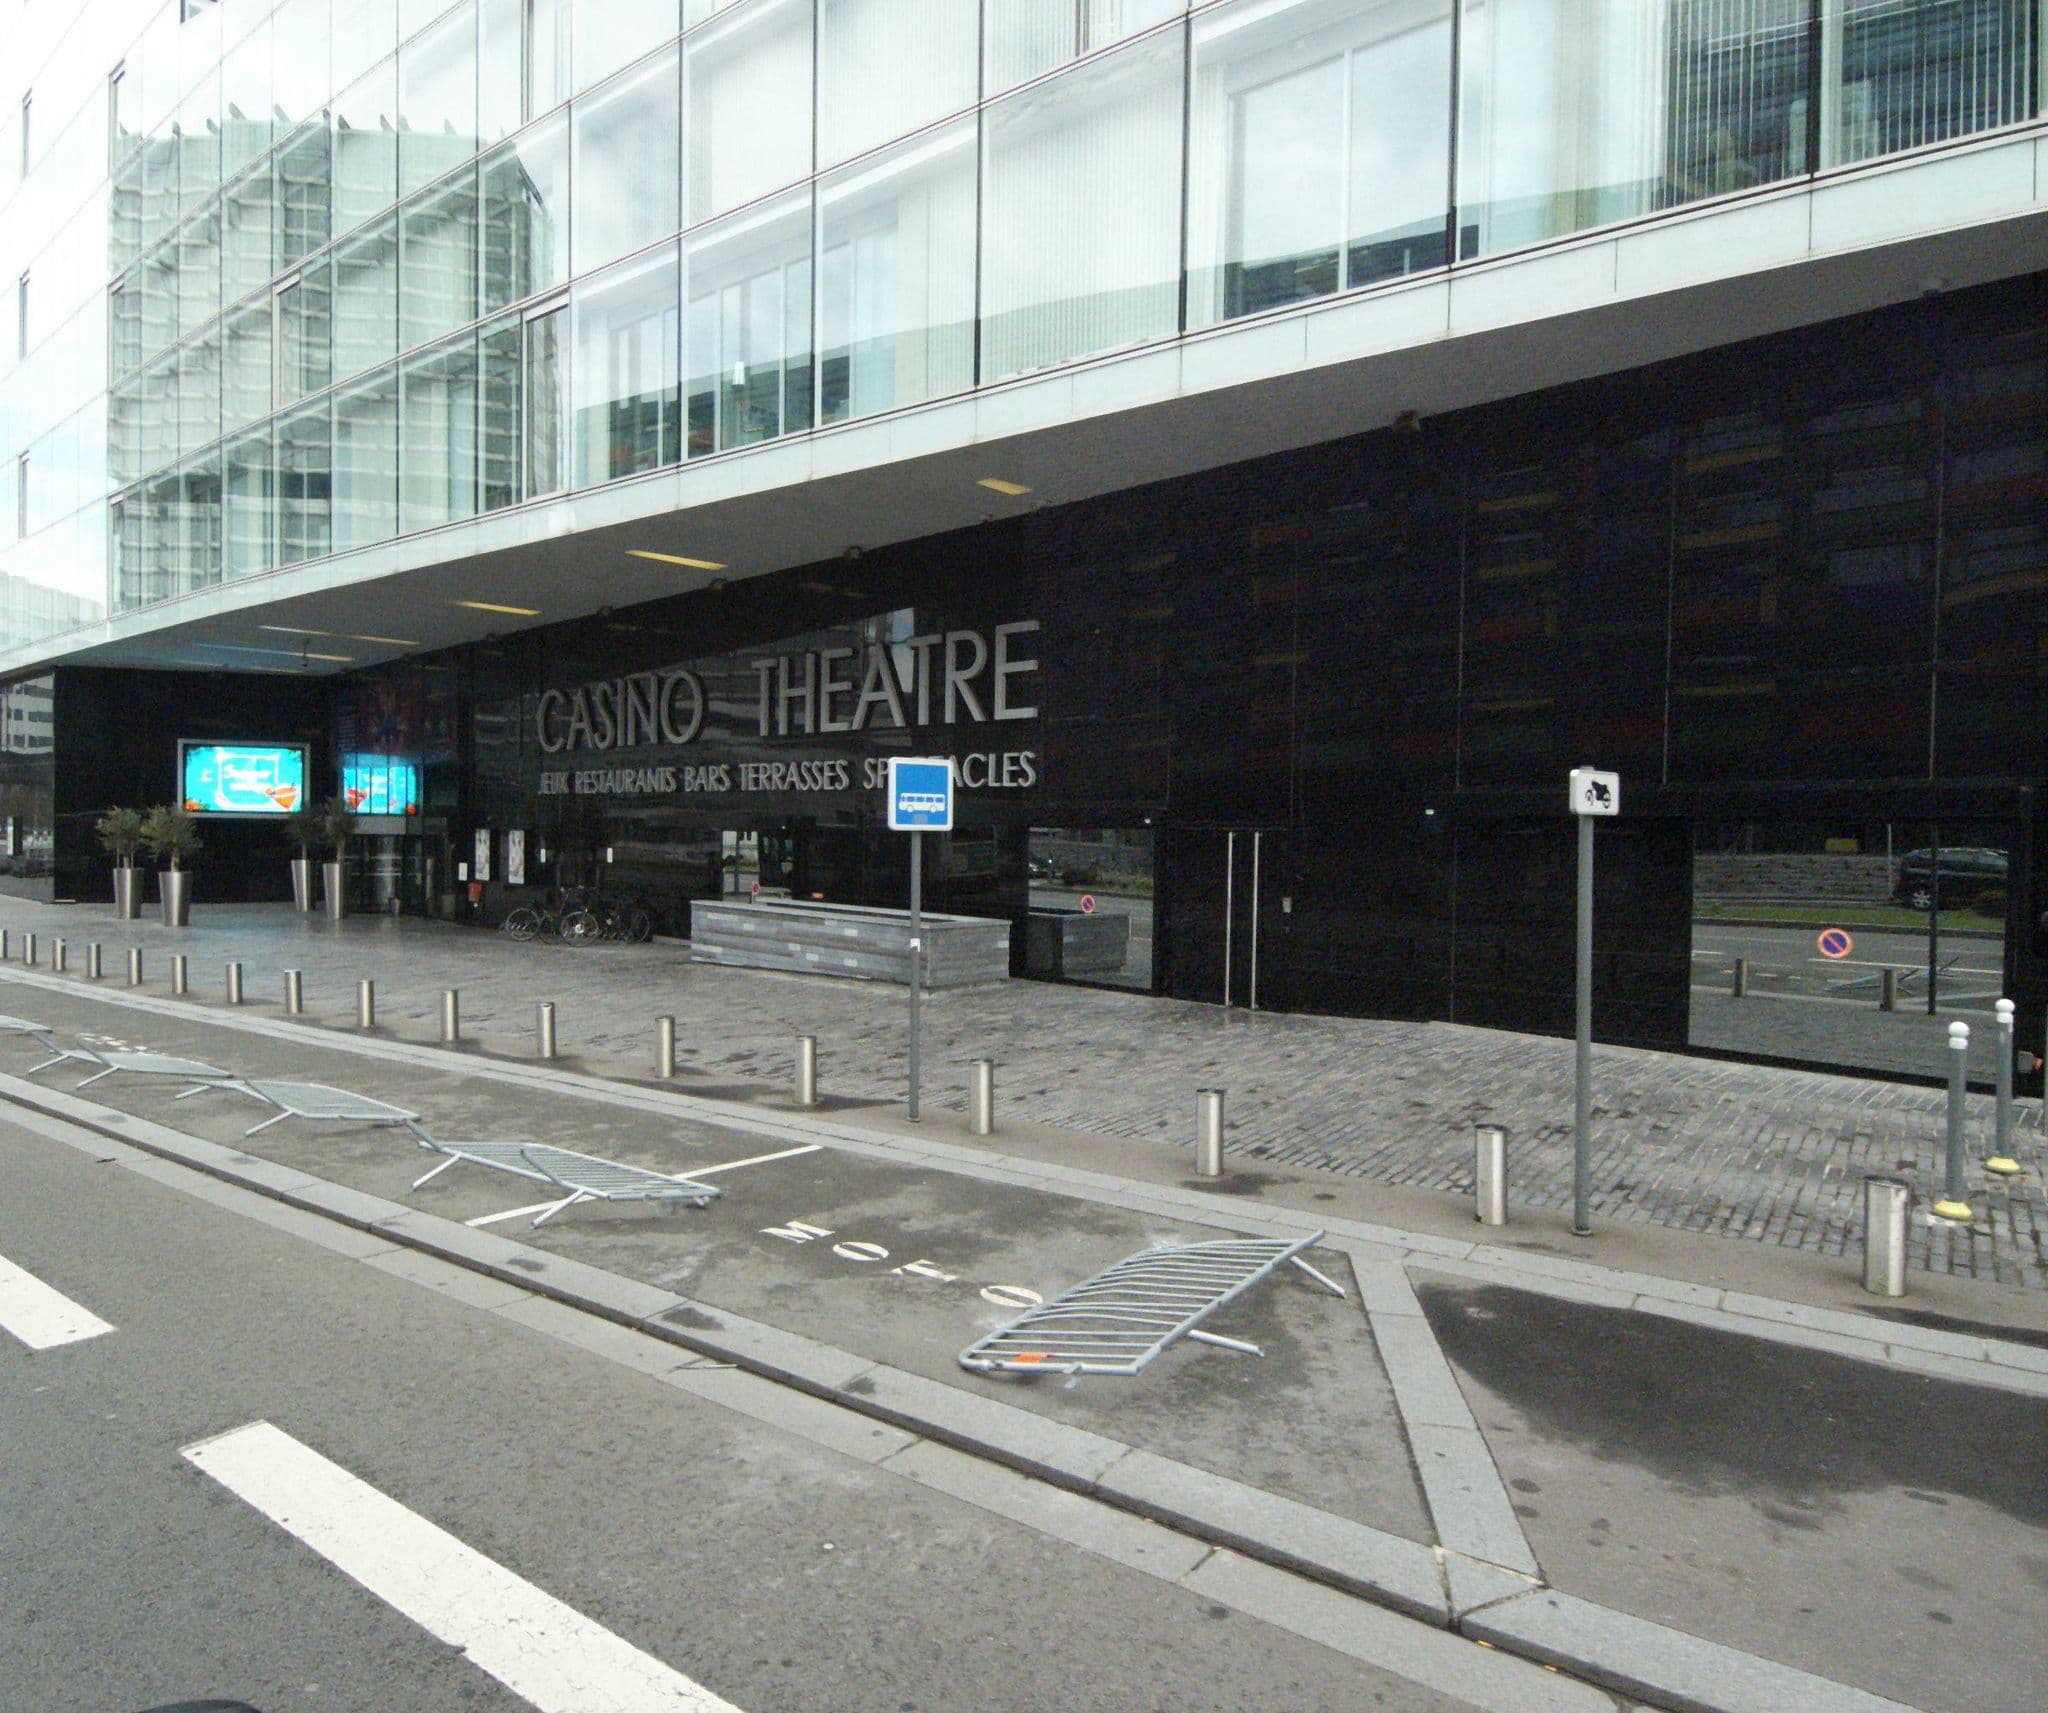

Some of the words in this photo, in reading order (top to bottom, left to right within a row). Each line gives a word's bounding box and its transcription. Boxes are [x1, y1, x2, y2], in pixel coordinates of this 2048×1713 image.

[537, 670, 704, 753] CASINO
[751, 620, 1041, 737] THEATRE
[538, 771, 570, 795] JEUX
[574, 766, 678, 794] RESTAURANTS
[684, 763, 732, 792] BARS
[738, 758, 850, 792] TERRASSES
[863, 749, 1038, 790] SPACLES
[758, 1219, 1044, 1309] MOTO
